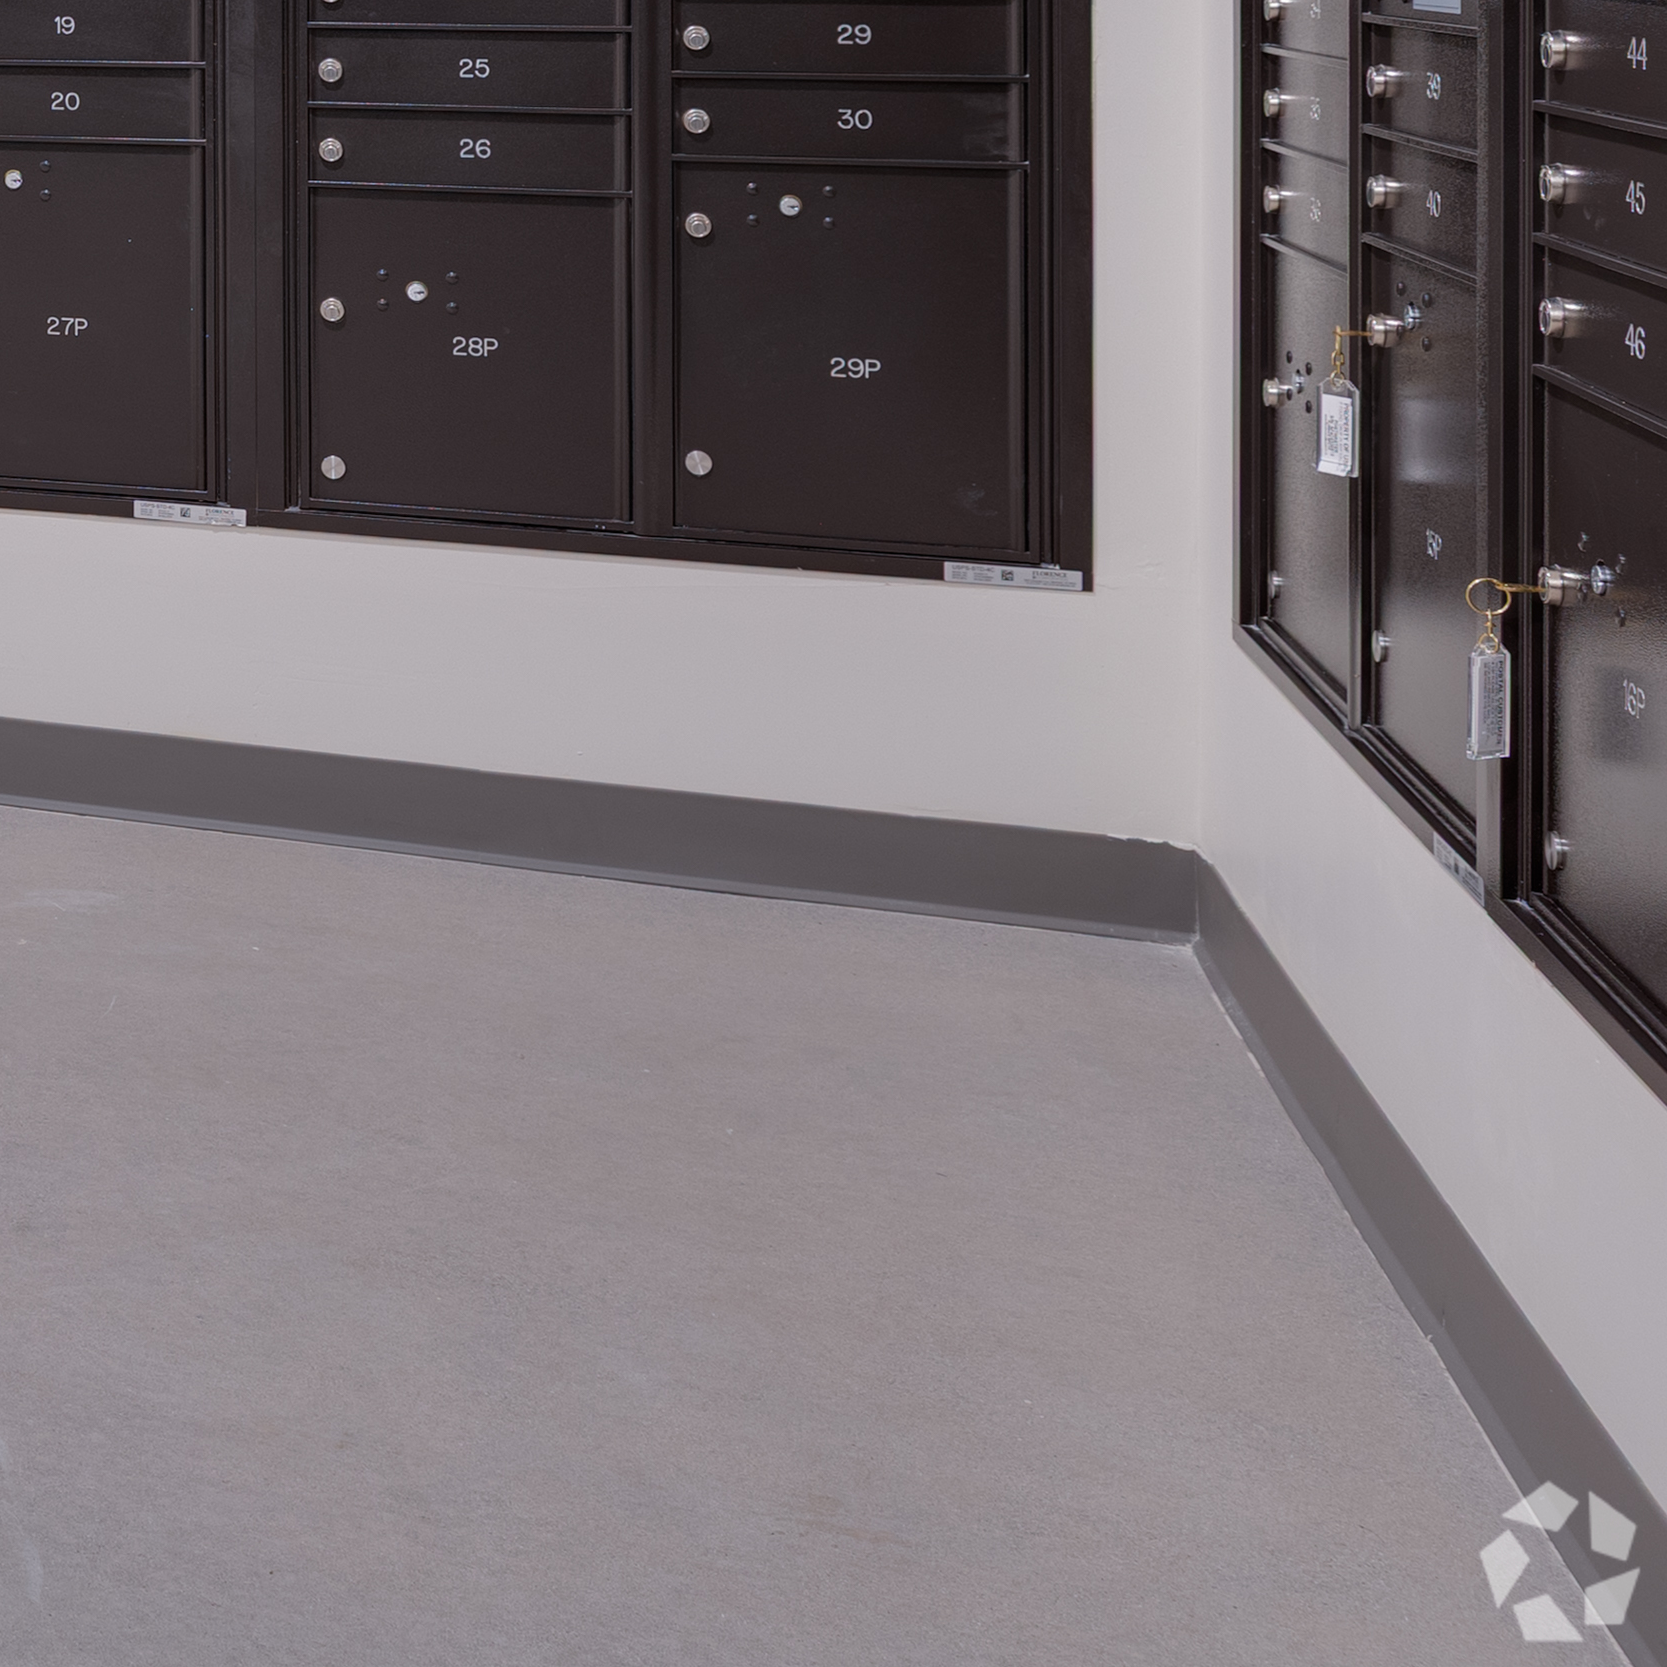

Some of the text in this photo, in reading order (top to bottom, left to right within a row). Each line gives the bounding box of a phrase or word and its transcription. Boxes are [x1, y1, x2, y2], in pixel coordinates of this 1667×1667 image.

[54, 15, 76, 35] 19
[837, 23, 872, 45] 29
[1626, 36, 1648, 71] 44
[459, 58, 490, 78] 25
[1426, 71, 1441, 100] 39
[51, 91, 80, 111] 20
[837, 108, 873, 130] 30
[459, 138, 491, 159] 26
[1426, 190, 1441, 218] 40
[1625, 180, 1646, 215] 45
[46, 316, 88, 337] 27P
[452, 336, 499, 357] 28P
[1624, 323, 1646, 360] 46
[830, 357, 881, 379] 29P
[1032, 570, 1068, 578] FLORENCE
[1622, 679, 1646, 719] 16P
